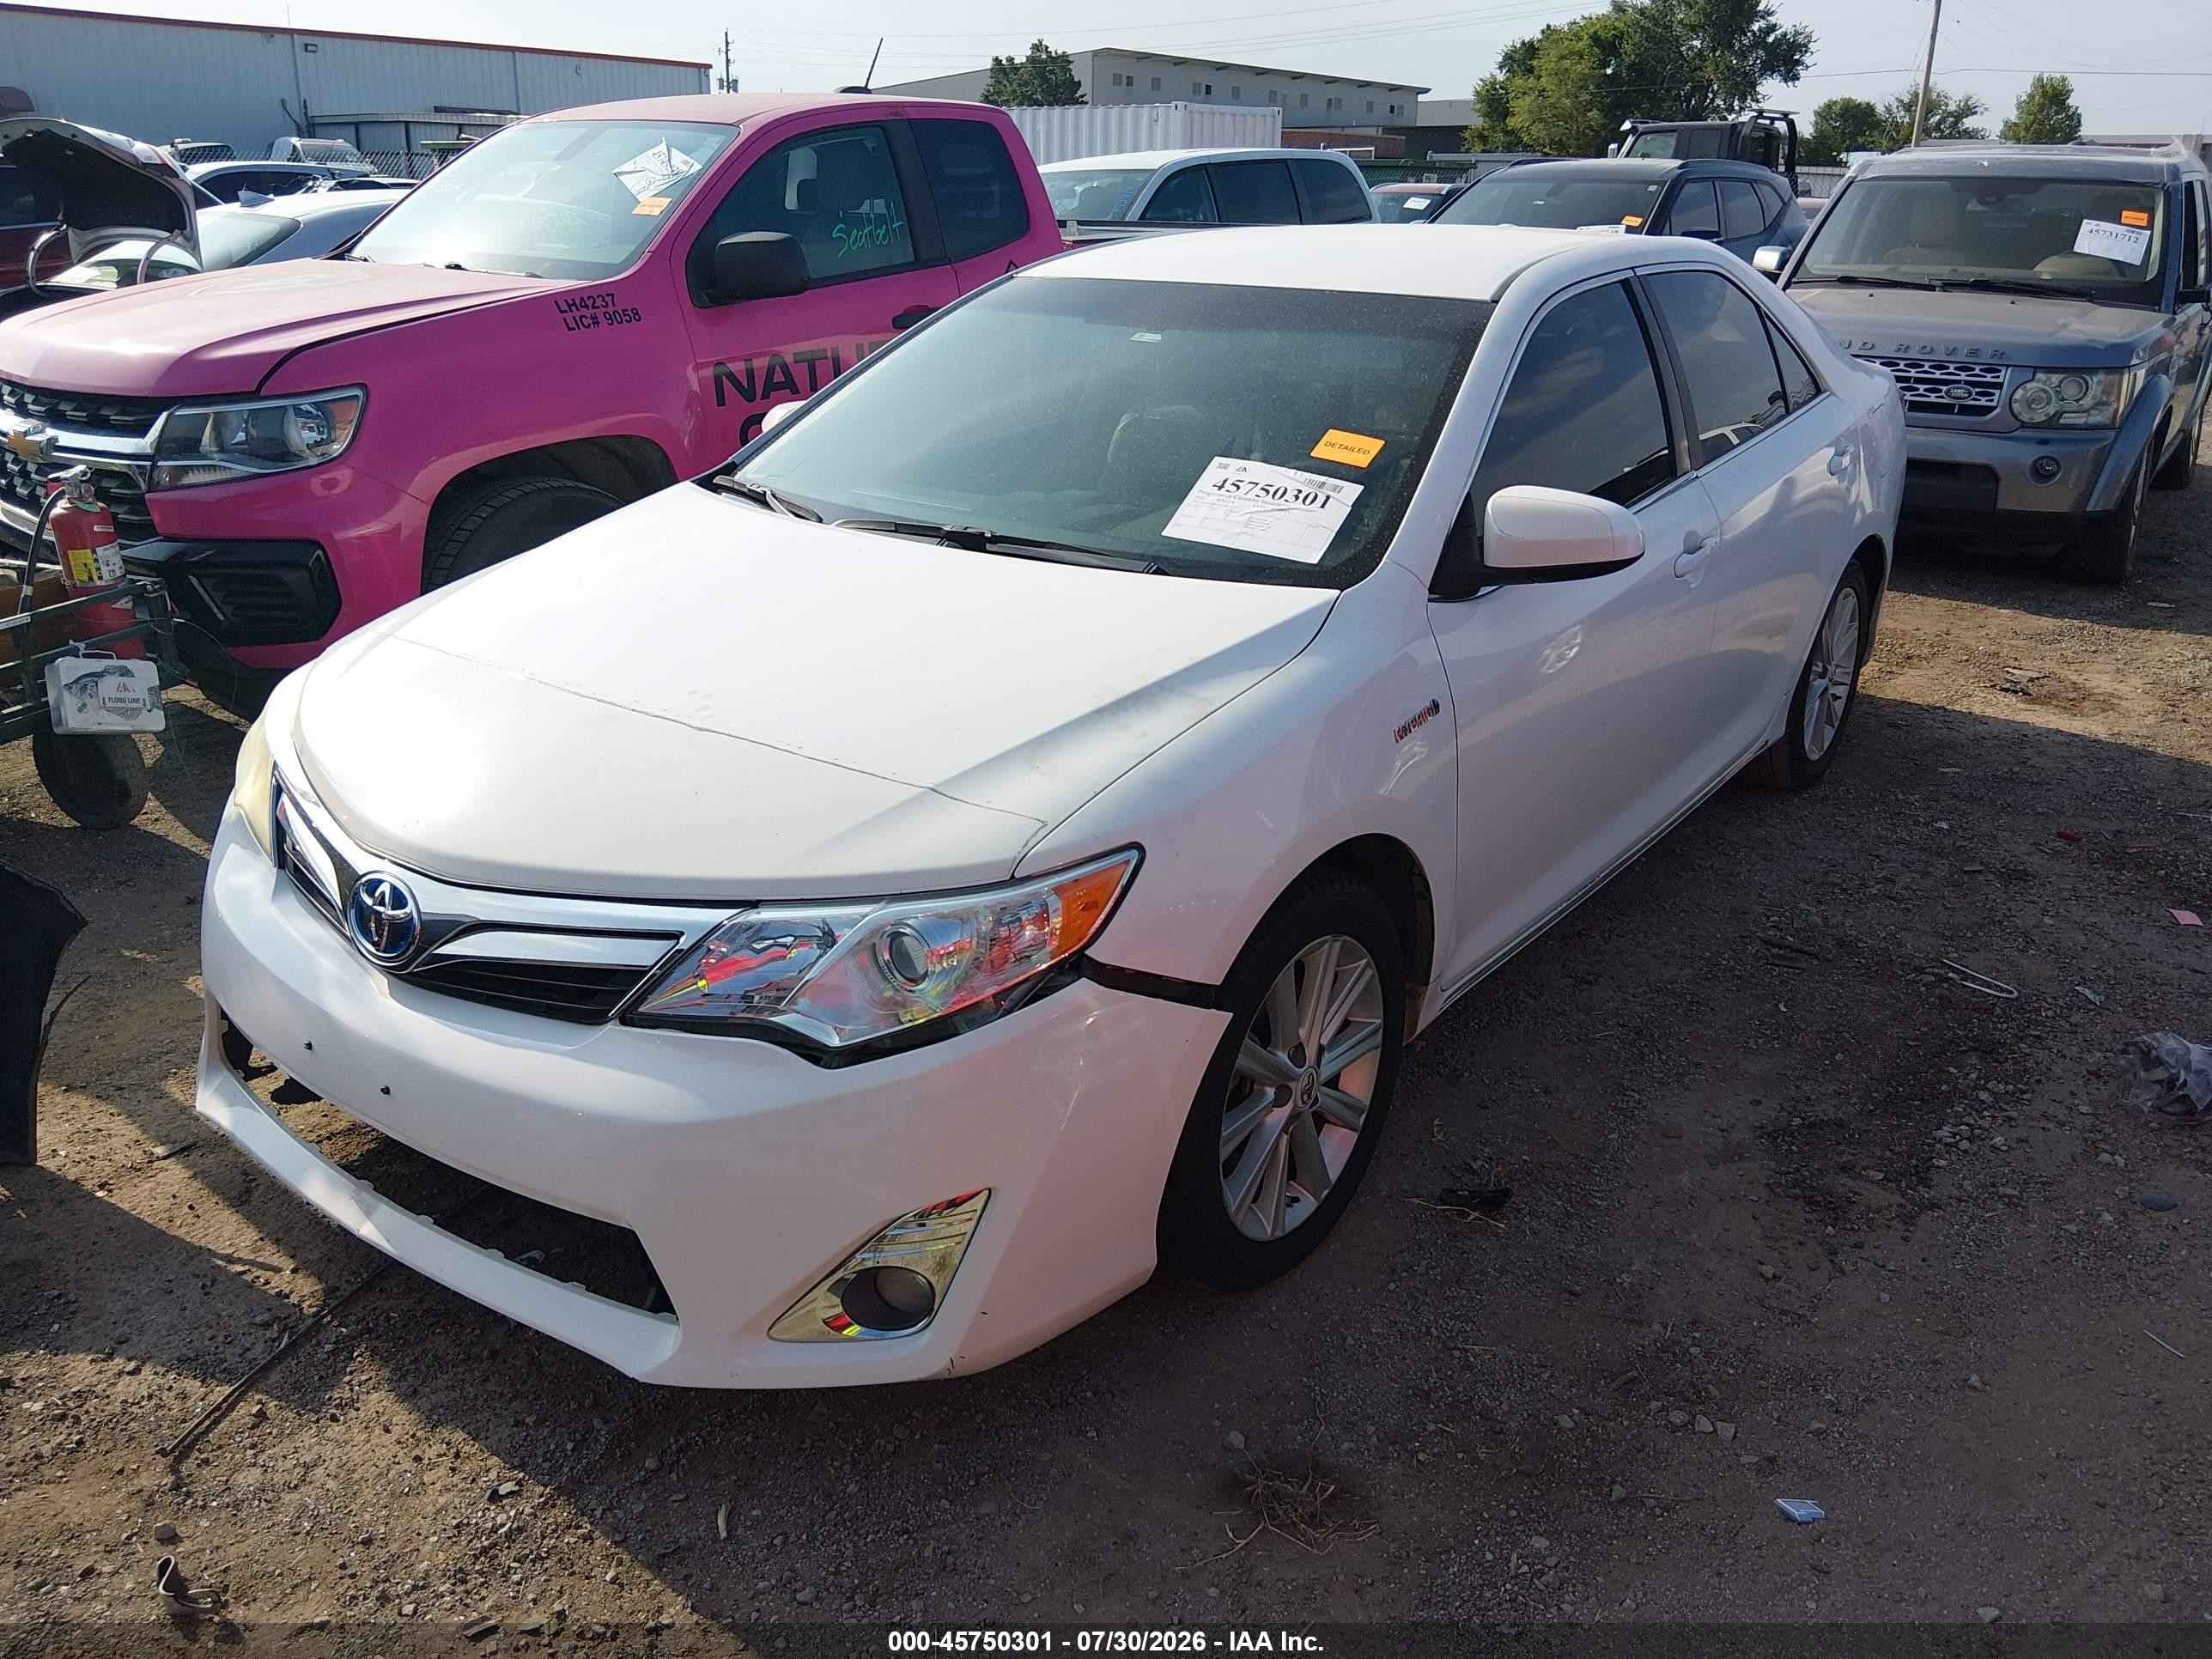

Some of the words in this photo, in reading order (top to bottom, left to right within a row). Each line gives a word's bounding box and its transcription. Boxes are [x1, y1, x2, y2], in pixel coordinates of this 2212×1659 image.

[2087, 228, 2140, 244] 45731712
[554, 293, 617, 314] LH4237
[562, 313, 600, 331] LIC#
[603, 307, 641, 326] 9058
[1893, 343, 2006, 359] ROVER
[1323, 441, 1370, 455] DETAILED
[1212, 477, 1332, 509] 45750301
